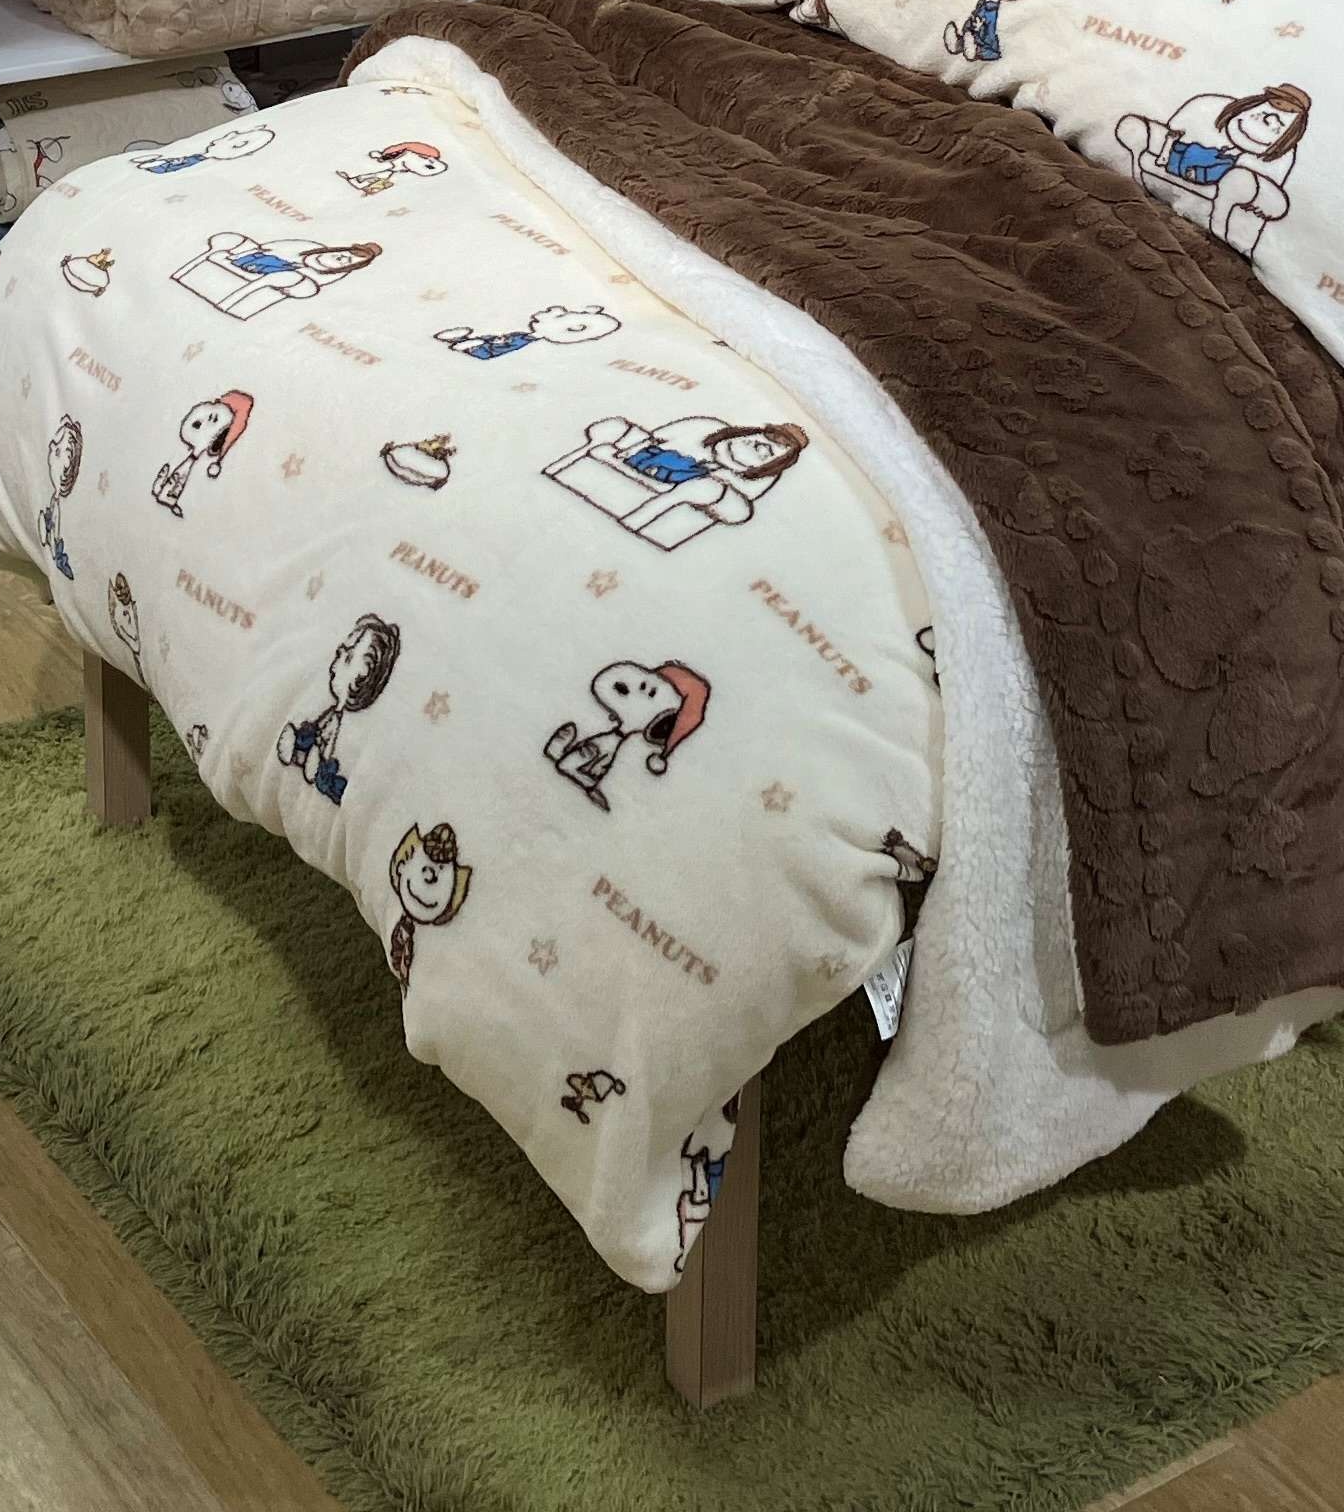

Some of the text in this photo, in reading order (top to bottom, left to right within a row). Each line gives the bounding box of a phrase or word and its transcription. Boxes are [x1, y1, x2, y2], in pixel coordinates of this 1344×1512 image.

[1083, 15, 1187, 61] PEANUTS
[248, 184, 313, 223] PEANUTS
[489, 212, 572, 256] PEANUTS
[298, 322, 382, 367] PEANUTS
[68, 346, 123, 393] PEANUTS
[608, 357, 699, 391] PEANUTS
[390, 540, 480, 600] PEANUTS
[175, 568, 257, 630] PEANUTS
[749, 579, 874, 696] PEANUTS
[592, 874, 720, 985] PEANUTS
